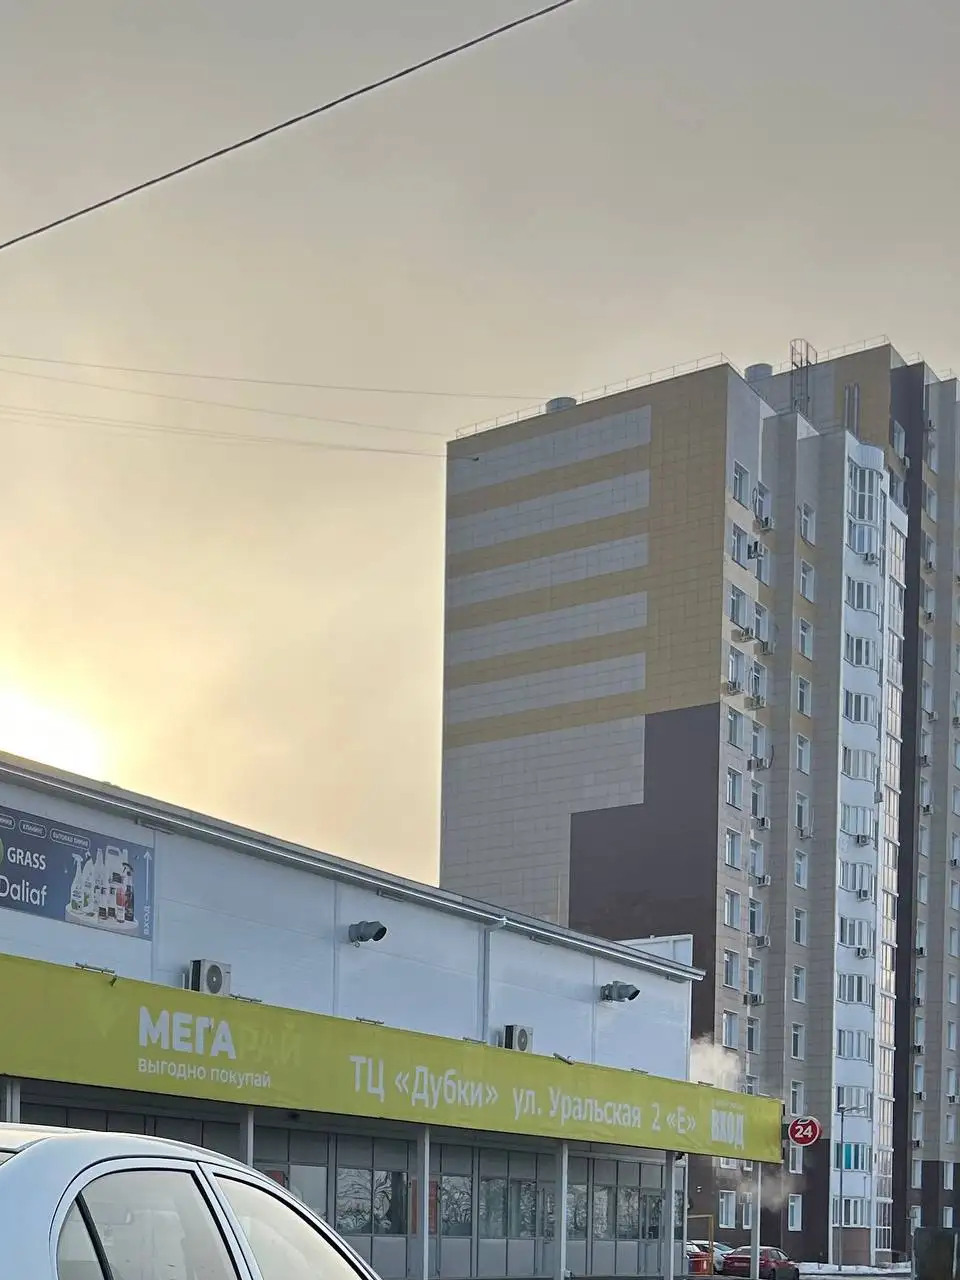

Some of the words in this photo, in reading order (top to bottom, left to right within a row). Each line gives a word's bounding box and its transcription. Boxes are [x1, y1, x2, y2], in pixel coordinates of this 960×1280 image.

[7, 846, 47, 871] GRASS
[210, 1069, 271, 1089] покупай
[349, 1055, 385, 1103] ТЦ
[395, 1065, 499, 1110] «Дубки»
[513, 1086, 542, 1121] ул.
[549, 1086, 641, 1129] Уральская
[652, 1102, 661, 1133] 2
[666, 1106, 696, 1134] «Е»
[711, 1108, 745, 1151] ВХОД
[794, 1124, 813, 1139] 24
